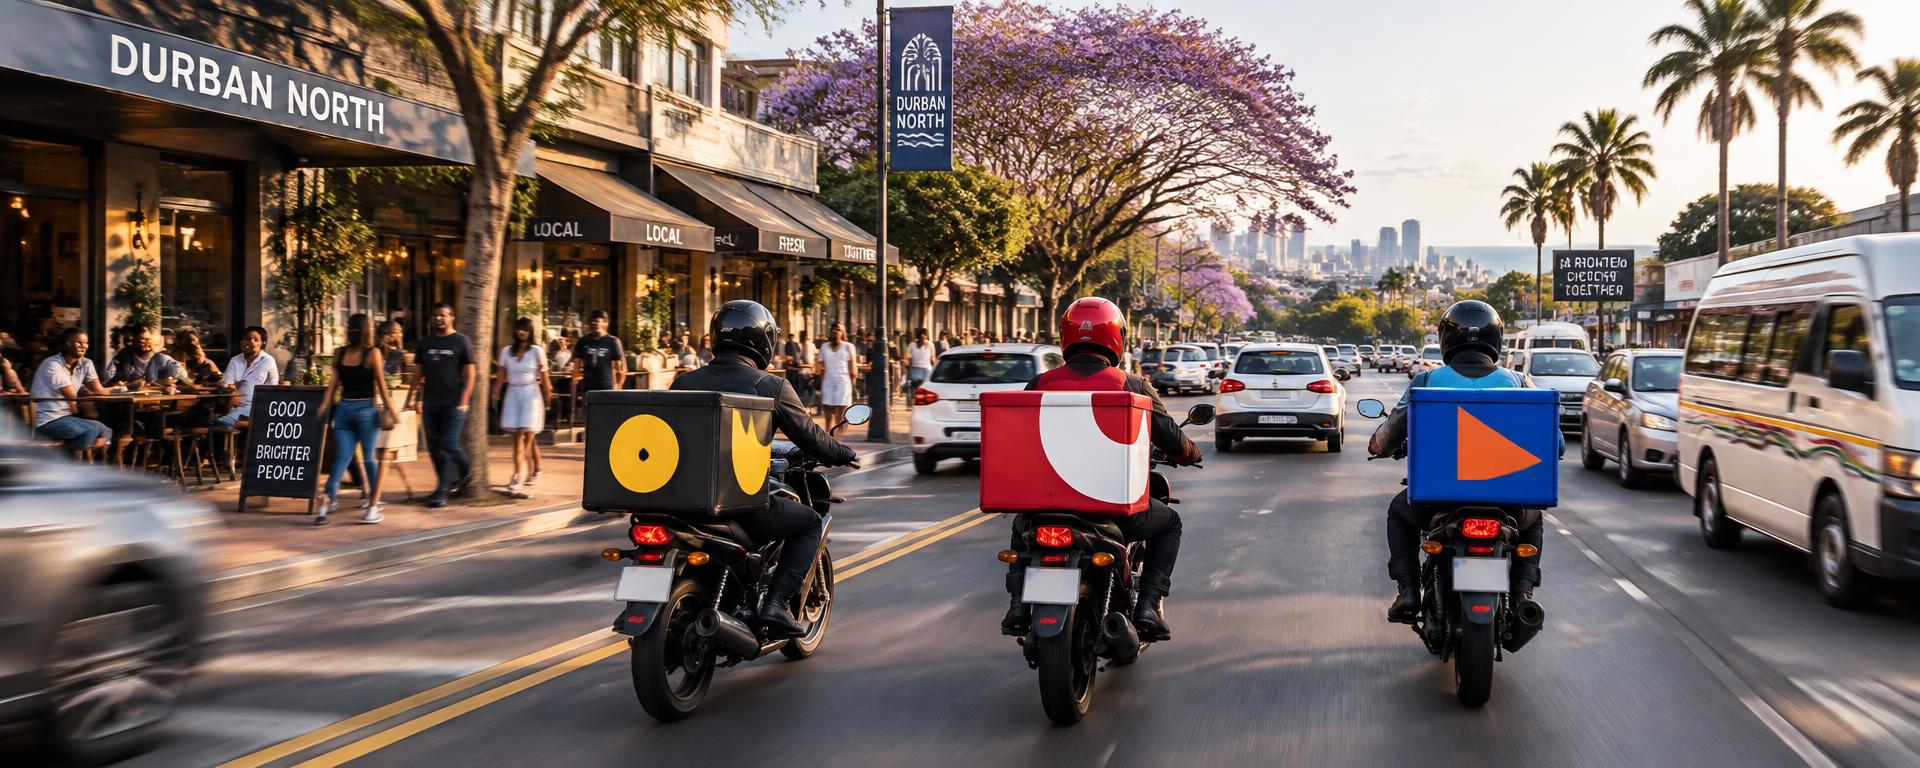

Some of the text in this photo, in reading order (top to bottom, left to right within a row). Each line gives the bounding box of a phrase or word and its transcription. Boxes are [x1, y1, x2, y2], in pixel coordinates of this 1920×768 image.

[111, 34, 384, 135] DURBAN NORTH
[897, 96, 946, 111] DURBAN
[897, 113, 944, 129] NORTH
[534, 222, 583, 237] LOCAL
[646, 224, 683, 245] LOCAL
[268, 401, 306, 417] GOOD
[266, 422, 303, 439] FOOD
[256, 444, 311, 461] BRIGHTER
[257, 465, 305, 481] PEOPLE
